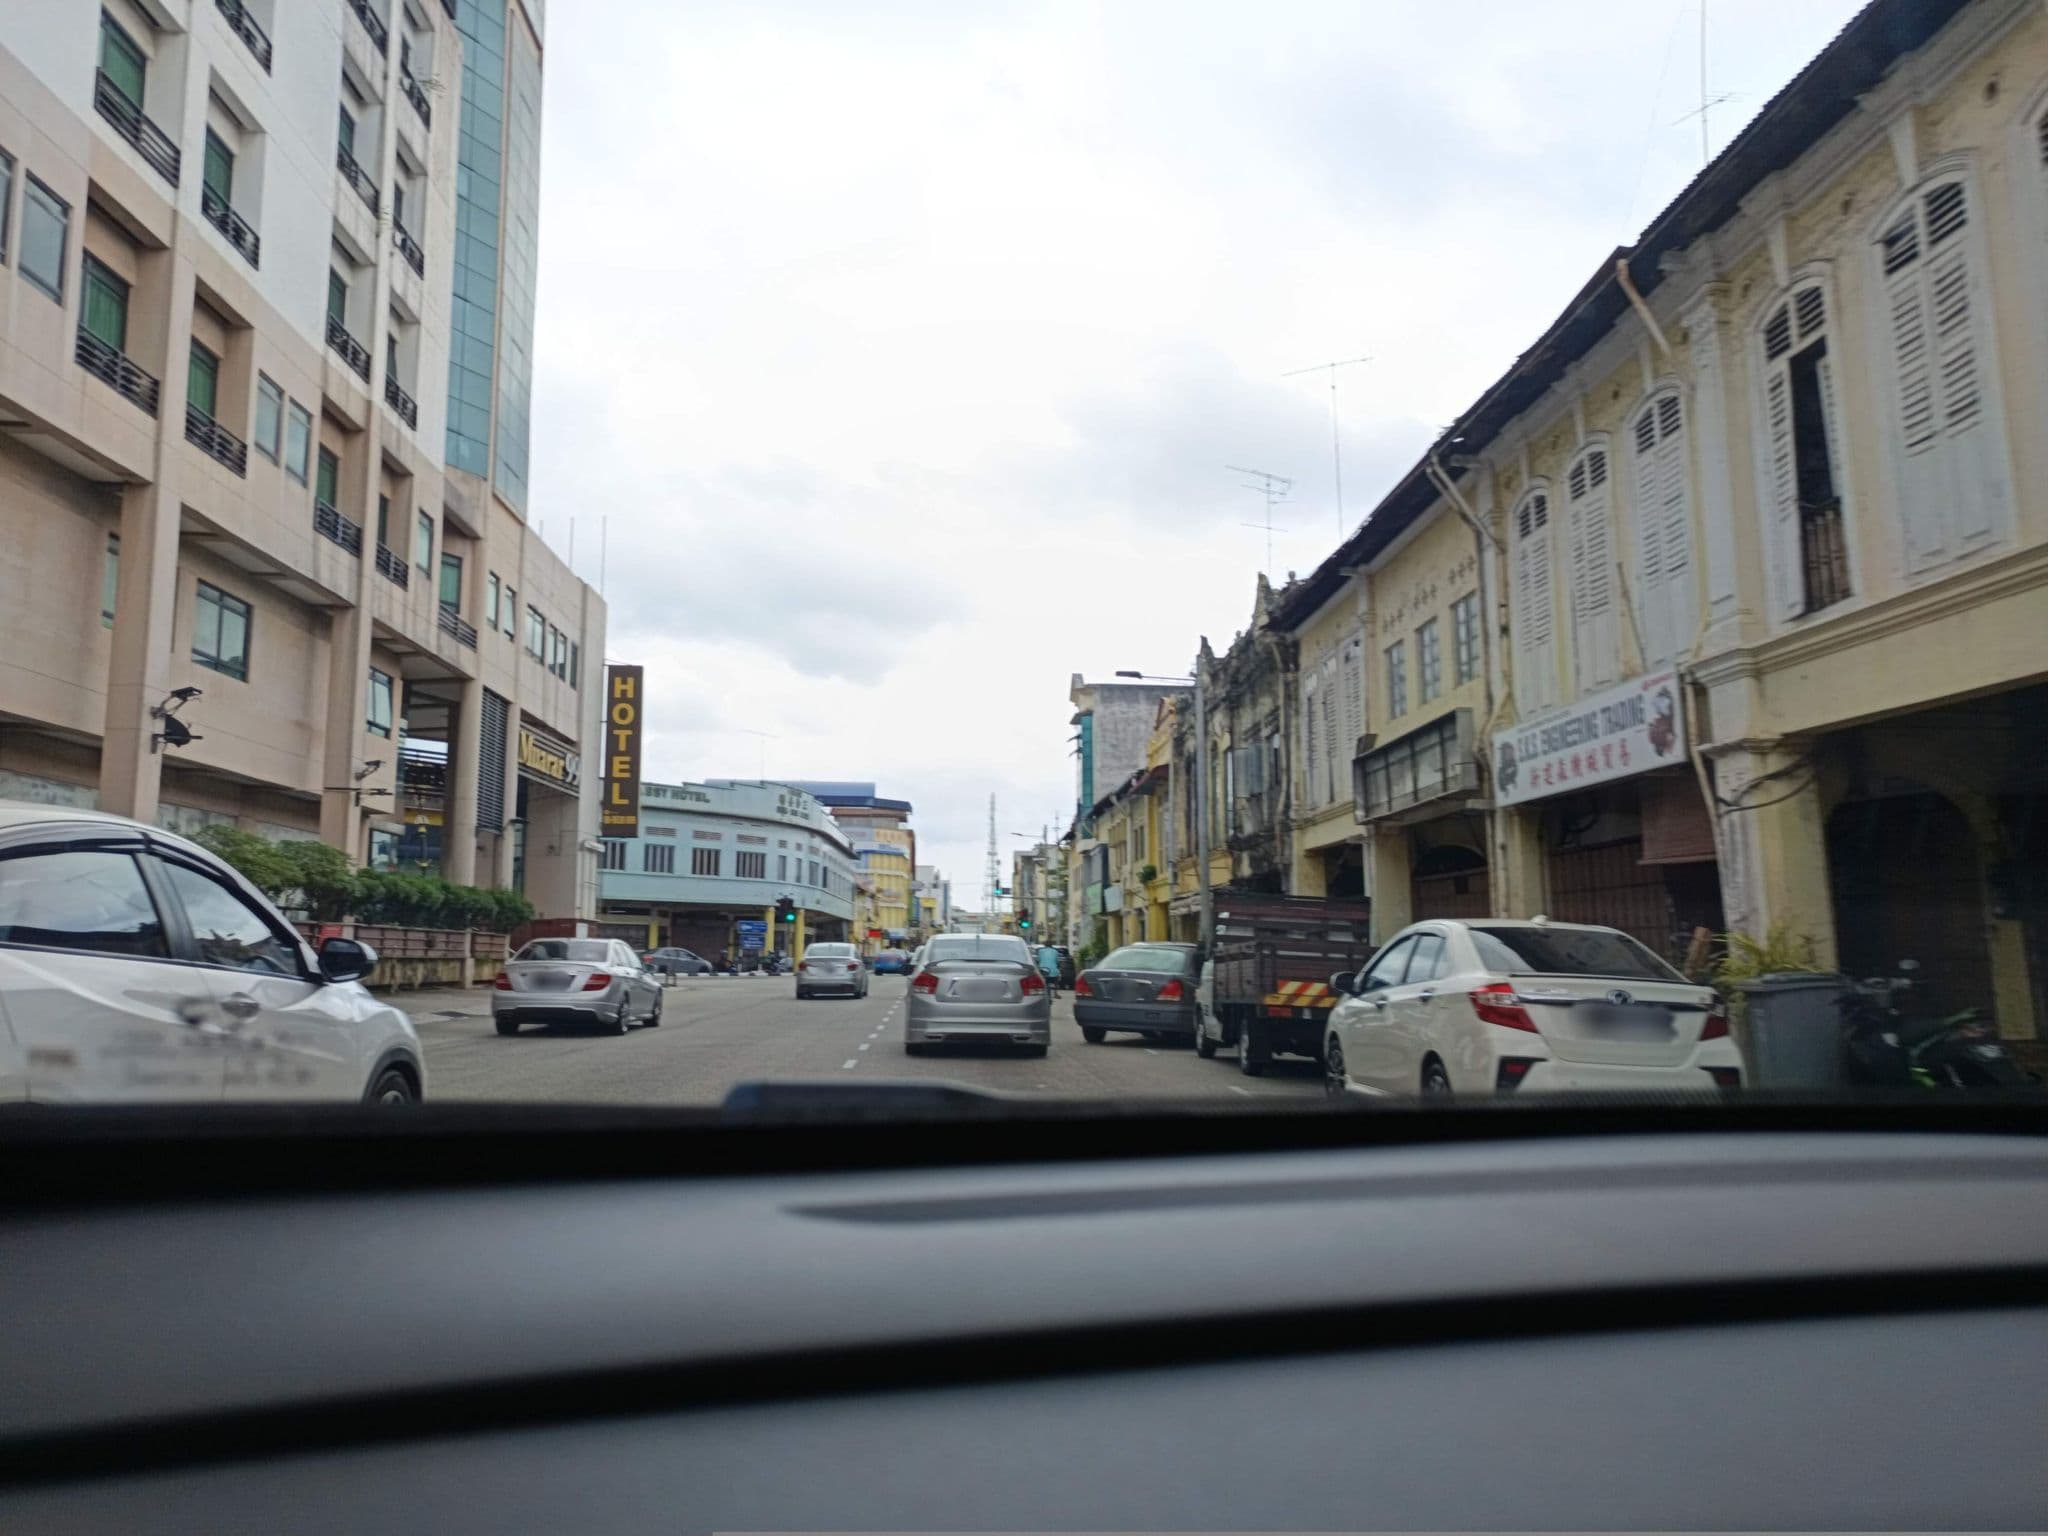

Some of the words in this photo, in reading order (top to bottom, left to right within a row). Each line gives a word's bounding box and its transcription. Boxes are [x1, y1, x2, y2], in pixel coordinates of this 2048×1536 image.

[1600, 693, 1646, 736] TRADING
[611, 676, 635, 805] HOTEL
[671, 789, 711, 803] HOTEL
